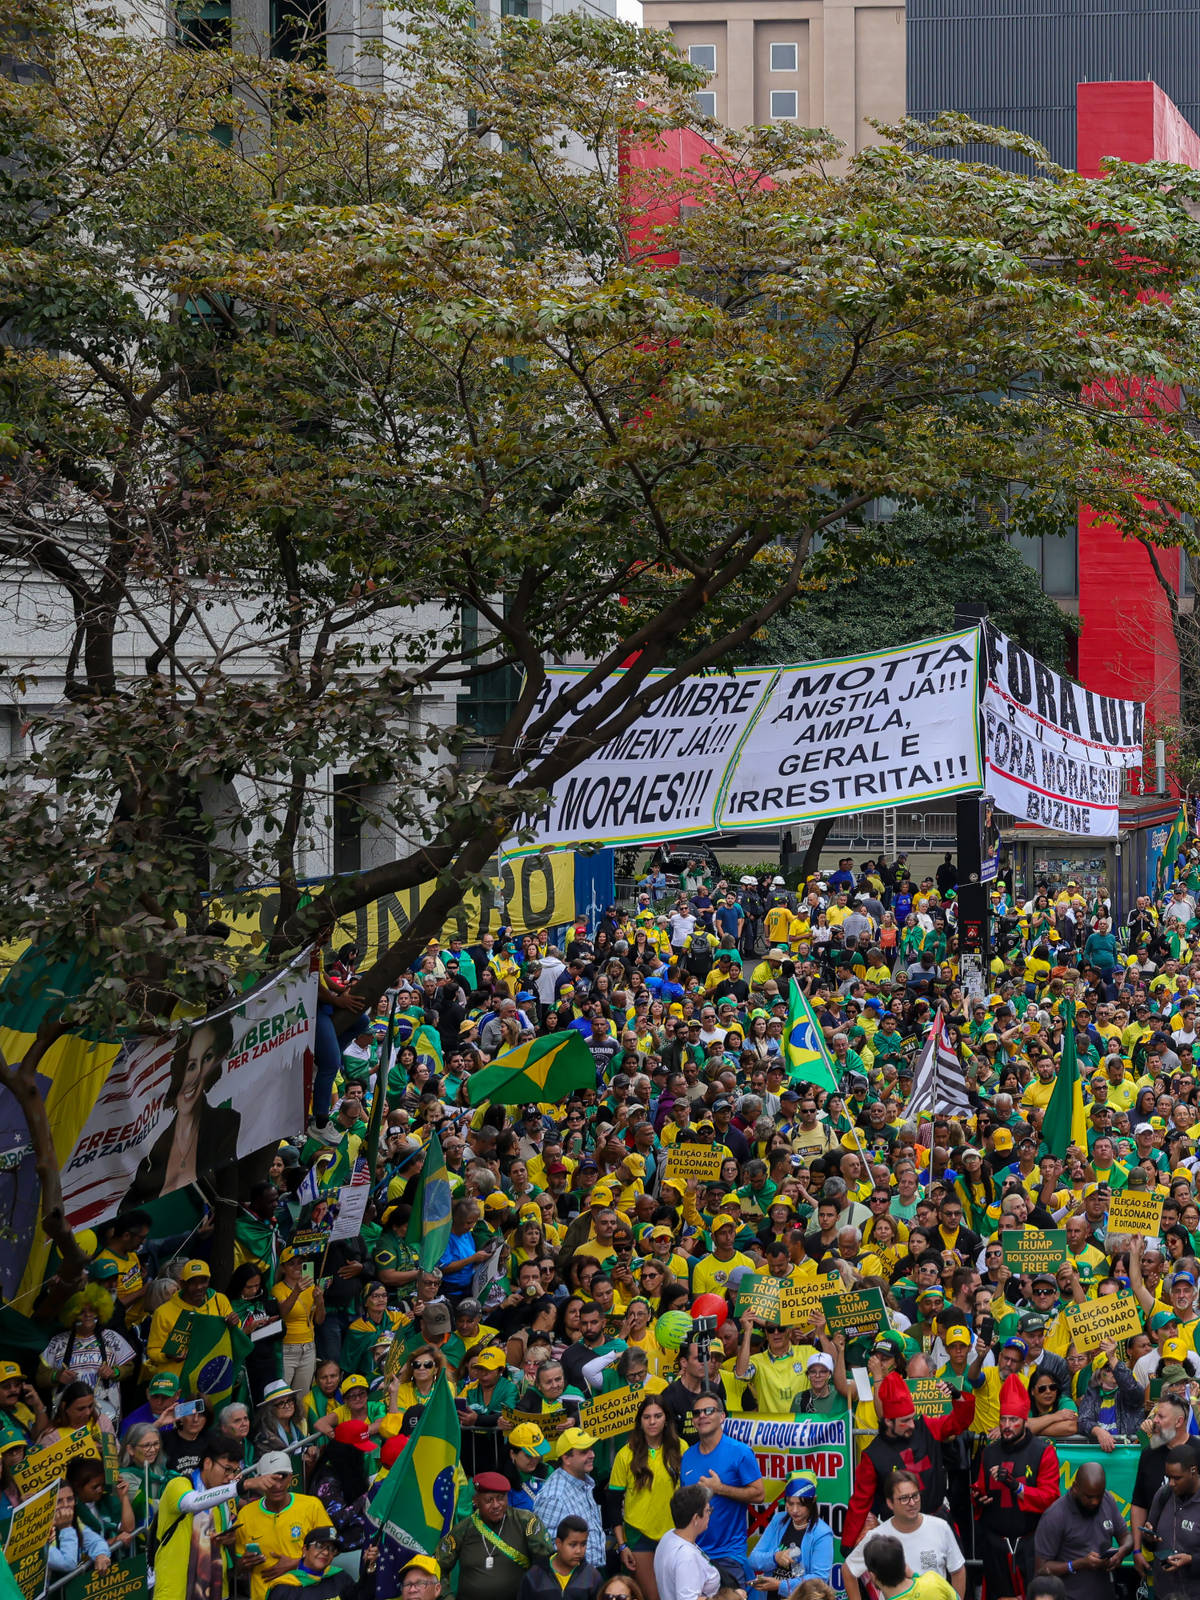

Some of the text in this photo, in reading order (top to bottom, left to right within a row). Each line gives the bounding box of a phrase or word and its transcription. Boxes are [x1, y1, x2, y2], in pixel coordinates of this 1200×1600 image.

[787, 643, 974, 699] MOTTA
[987, 622, 1144, 747] FORA LULA
[771, 669, 968, 724] ANISTIA JÁ!!!
[677, 717, 738, 758] JÁ!!!
[793, 708, 911, 746] AMPLA,
[778, 733, 920, 776] GERAL E
[729, 755, 969, 814] IRRESTRITA!!!
[557, 768, 713, 832] MORAES!!!
[1026, 792, 1091, 833] BUZINE
[226, 1019, 309, 1074] PER ZAMBELLI
[74, 1092, 166, 1158] FREEDOM
[67, 1148, 96, 1174] POR
[98, 1111, 160, 1157] ZAMBELLI
[673, 1149, 702, 1158] ELEIÇÃO
[668, 1157, 720, 1168] BOLSONARO
[679, 1168, 714, 1176] DITADURA
[1110, 1207, 1159, 1221] BOLSONARO
[1114, 1197, 1157, 1209] ELEIÇÃO SEM
[1023, 1231, 1045, 1240] SOS
[1114, 1218, 1151, 1230] É DITADURA
[1017, 1240, 1053, 1250] TRUMP
[1007, 1253, 1062, 1262] BOLSONARO
[1022, 1262, 1049, 1273] FREE
[785, 1282, 835, 1296] ELEIÇÃO SEM
[839, 1292, 860, 1303] SOS
[835, 1301, 870, 1315] TRUMP
[1073, 1300, 1129, 1323] ELEIÇÃO SEM
[830, 1312, 882, 1329] BOLSONARO
[1072, 1308, 1136, 1337] BOLSONARO
[1083, 1323, 1133, 1345] É DITADURA
[586, 1392, 640, 1417] ELEIÇÃO SEM
[592, 1427, 597, 1437] É
[754, 1418, 845, 1449] PORQUE É MAIOR
[21, 1438, 87, 1480] ELEIÇÃO SEM
[754, 1452, 843, 1480] TRUMP
[15, 1507, 43, 1531] ELEIÇÃO
[14, 1559, 43, 1582] TRUMP
[19, 1551, 40, 1570] SOS
[84, 1570, 130, 1595] TRUMP
